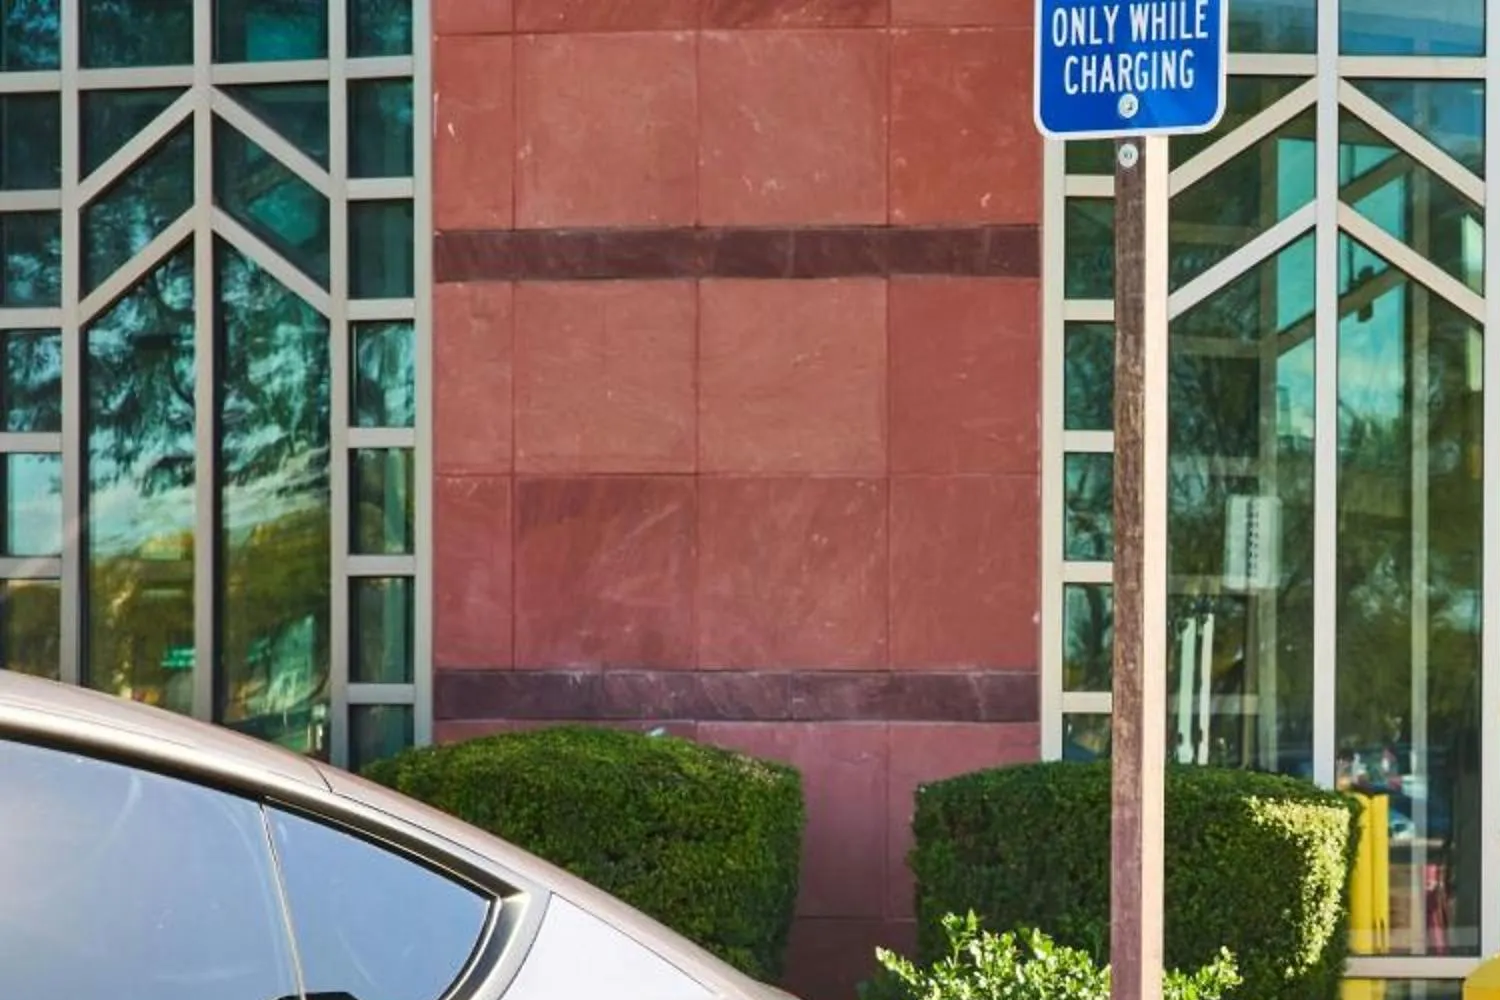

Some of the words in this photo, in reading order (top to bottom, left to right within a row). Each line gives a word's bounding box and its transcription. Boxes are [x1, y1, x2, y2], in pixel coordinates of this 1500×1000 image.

[1052, 4, 1119, 47] ONLY
[1129, 0, 1209, 42] WHILE
[1064, 49, 1195, 95] CHARGING
